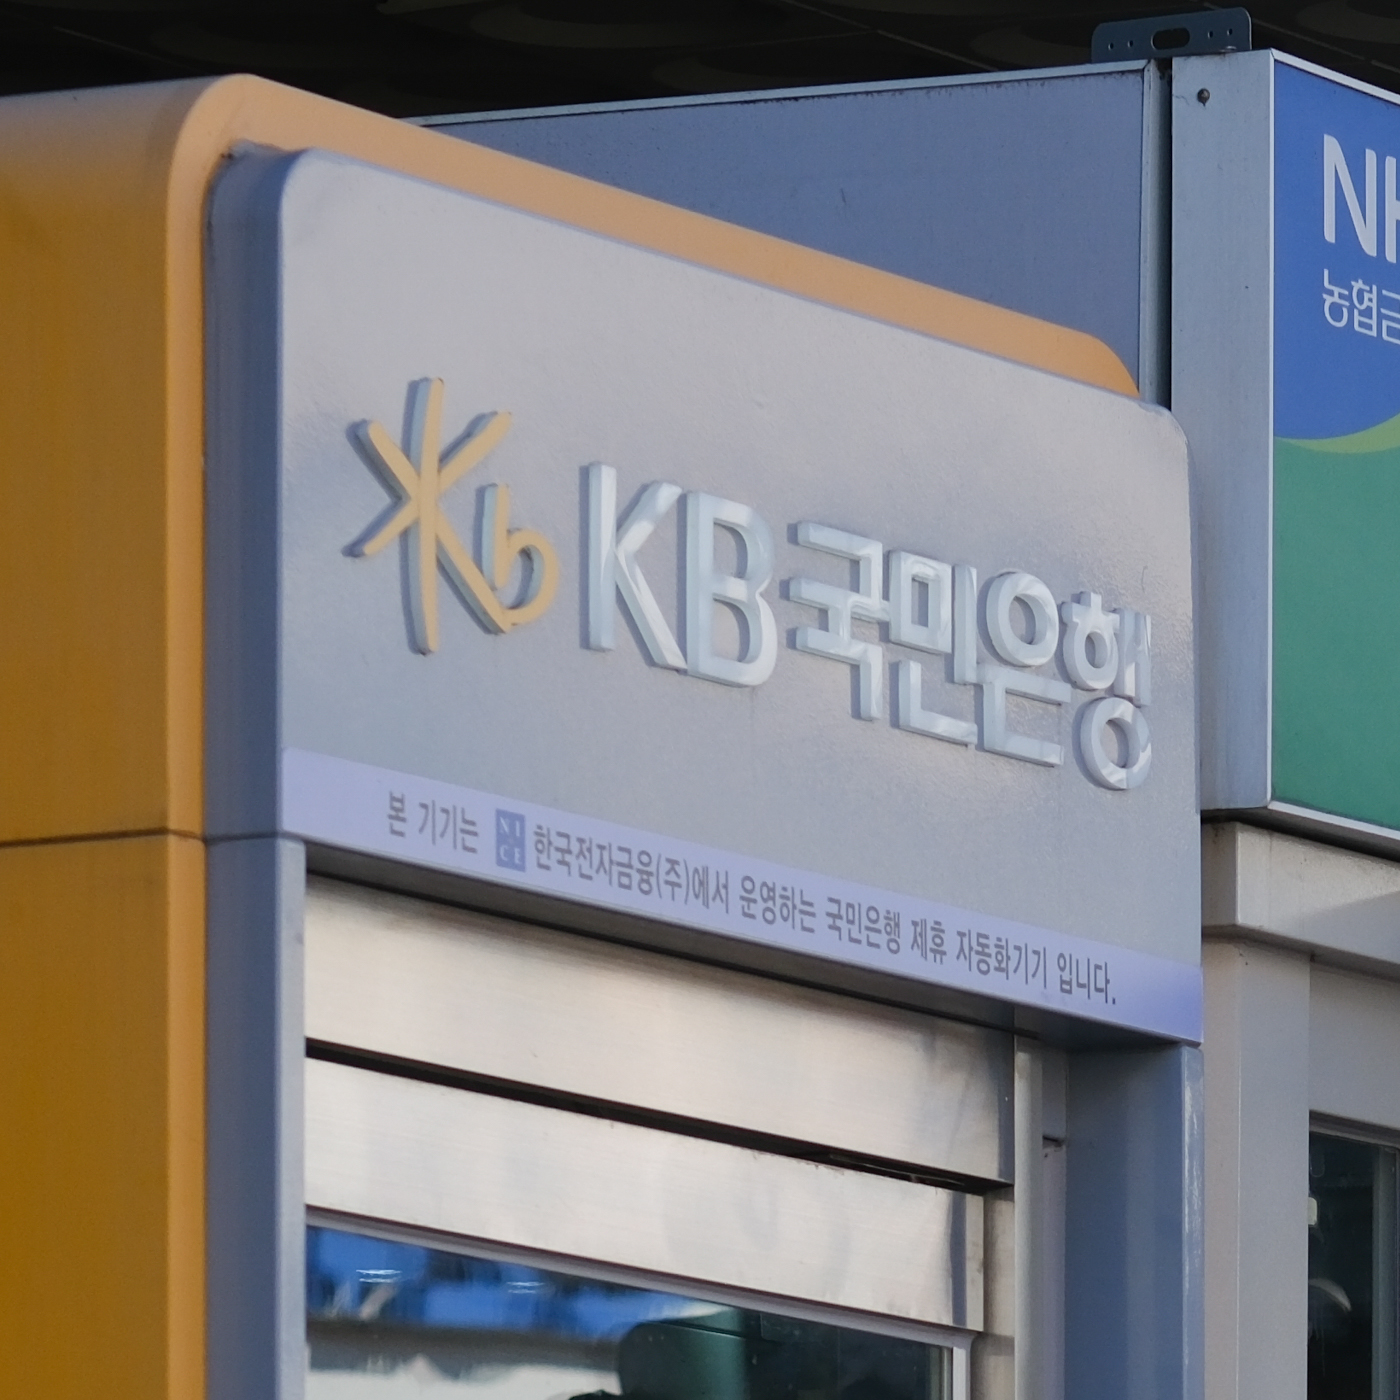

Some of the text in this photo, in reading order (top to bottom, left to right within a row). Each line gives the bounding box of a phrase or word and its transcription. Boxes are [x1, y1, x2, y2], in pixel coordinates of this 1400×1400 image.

[579, 461, 1153, 791] KB국민은행
[386, 790, 479, 854] 본 기기는
[533, 823, 1117, 1006] 한국전자금융(주)에서 운영하는 국민은행 제휴 자동화기기 입니다.
